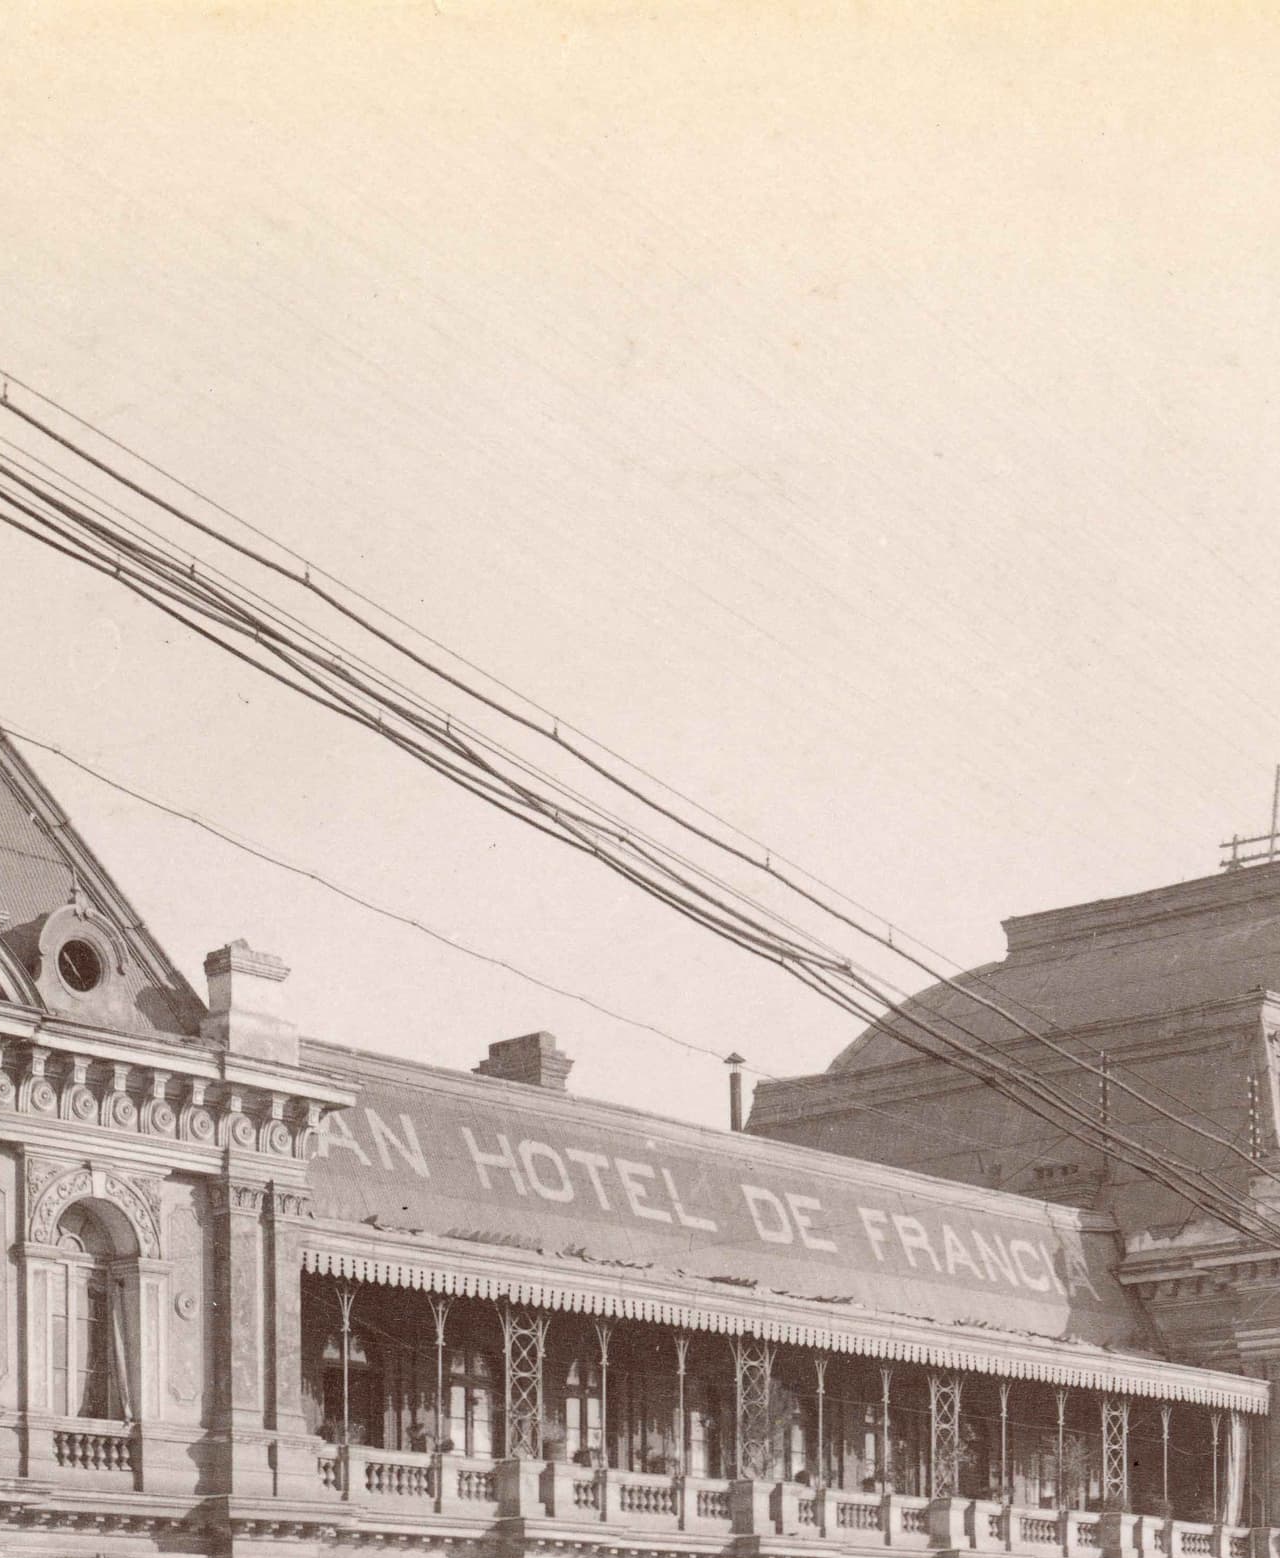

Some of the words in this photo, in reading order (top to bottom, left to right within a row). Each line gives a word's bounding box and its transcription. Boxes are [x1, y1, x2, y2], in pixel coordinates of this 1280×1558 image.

[461, 1126, 718, 1233] HOTEL
[740, 1183, 838, 1254] DE
[857, 1206, 1103, 1303] FRANCIA
